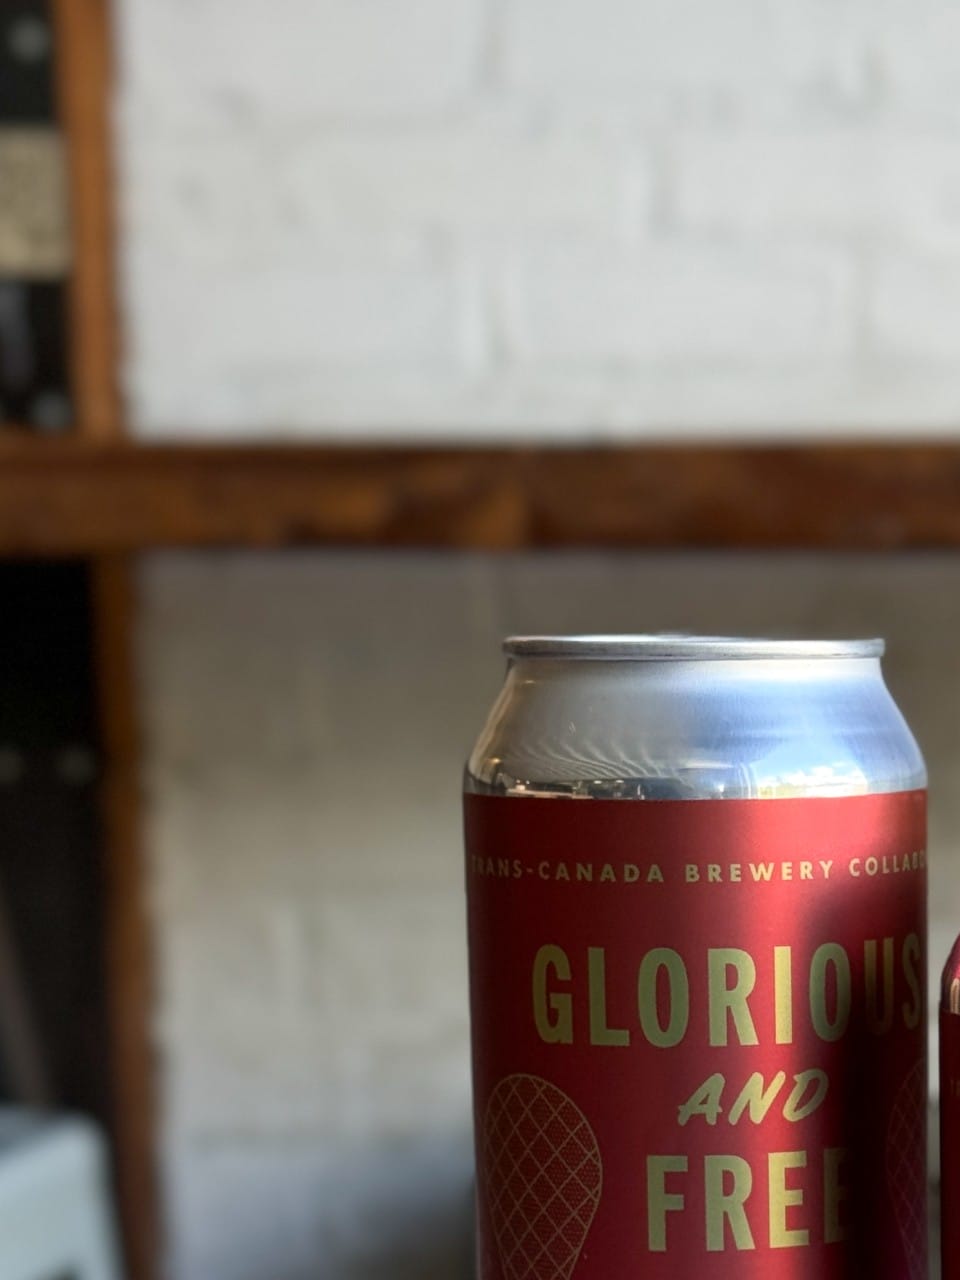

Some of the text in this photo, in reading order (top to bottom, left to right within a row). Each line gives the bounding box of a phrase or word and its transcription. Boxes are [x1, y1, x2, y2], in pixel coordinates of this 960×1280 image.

[685, 860, 834, 883] BREWERY
[532, 932, 922, 1048] GLORIOUS
[678, 1070, 829, 1126] AND
